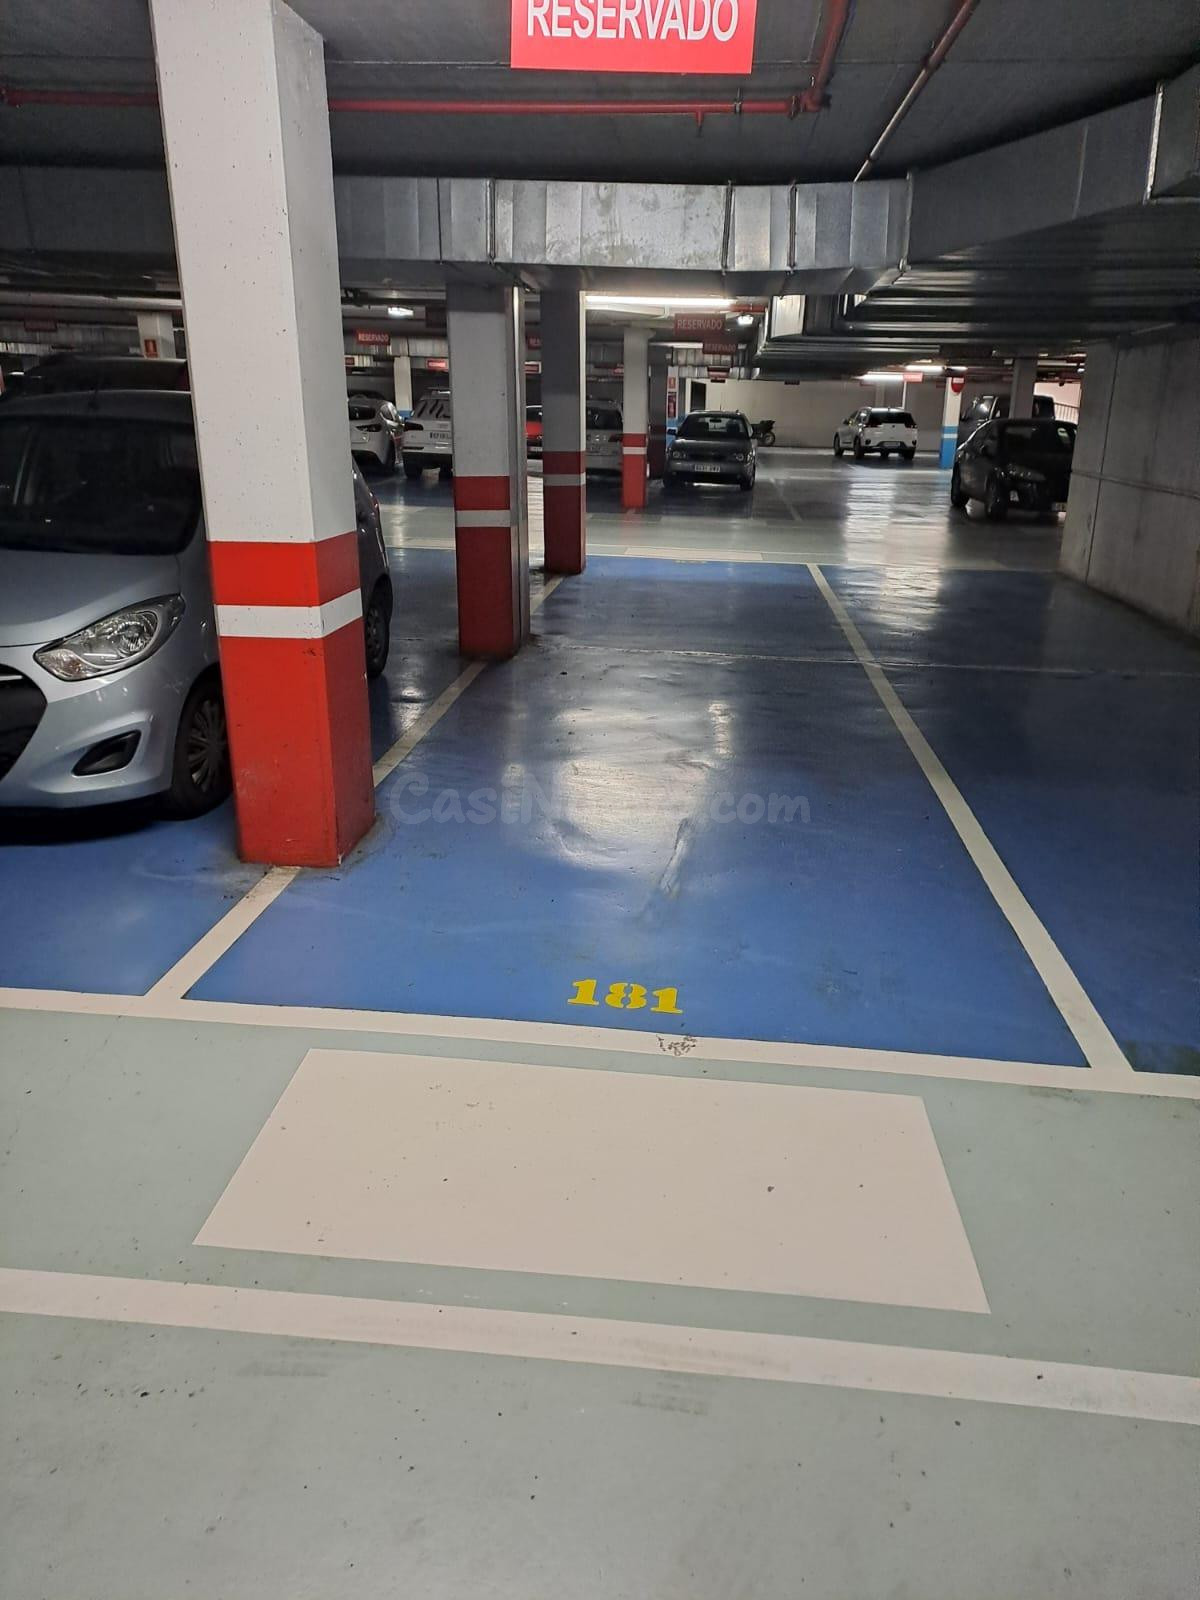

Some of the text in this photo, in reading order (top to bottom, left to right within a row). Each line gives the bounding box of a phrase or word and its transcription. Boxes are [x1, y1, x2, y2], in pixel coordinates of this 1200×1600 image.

[527, 0, 739, 42] RESERVADO
[677, 319, 722, 330] RESERVADO
[567, 978, 684, 1015] 181
